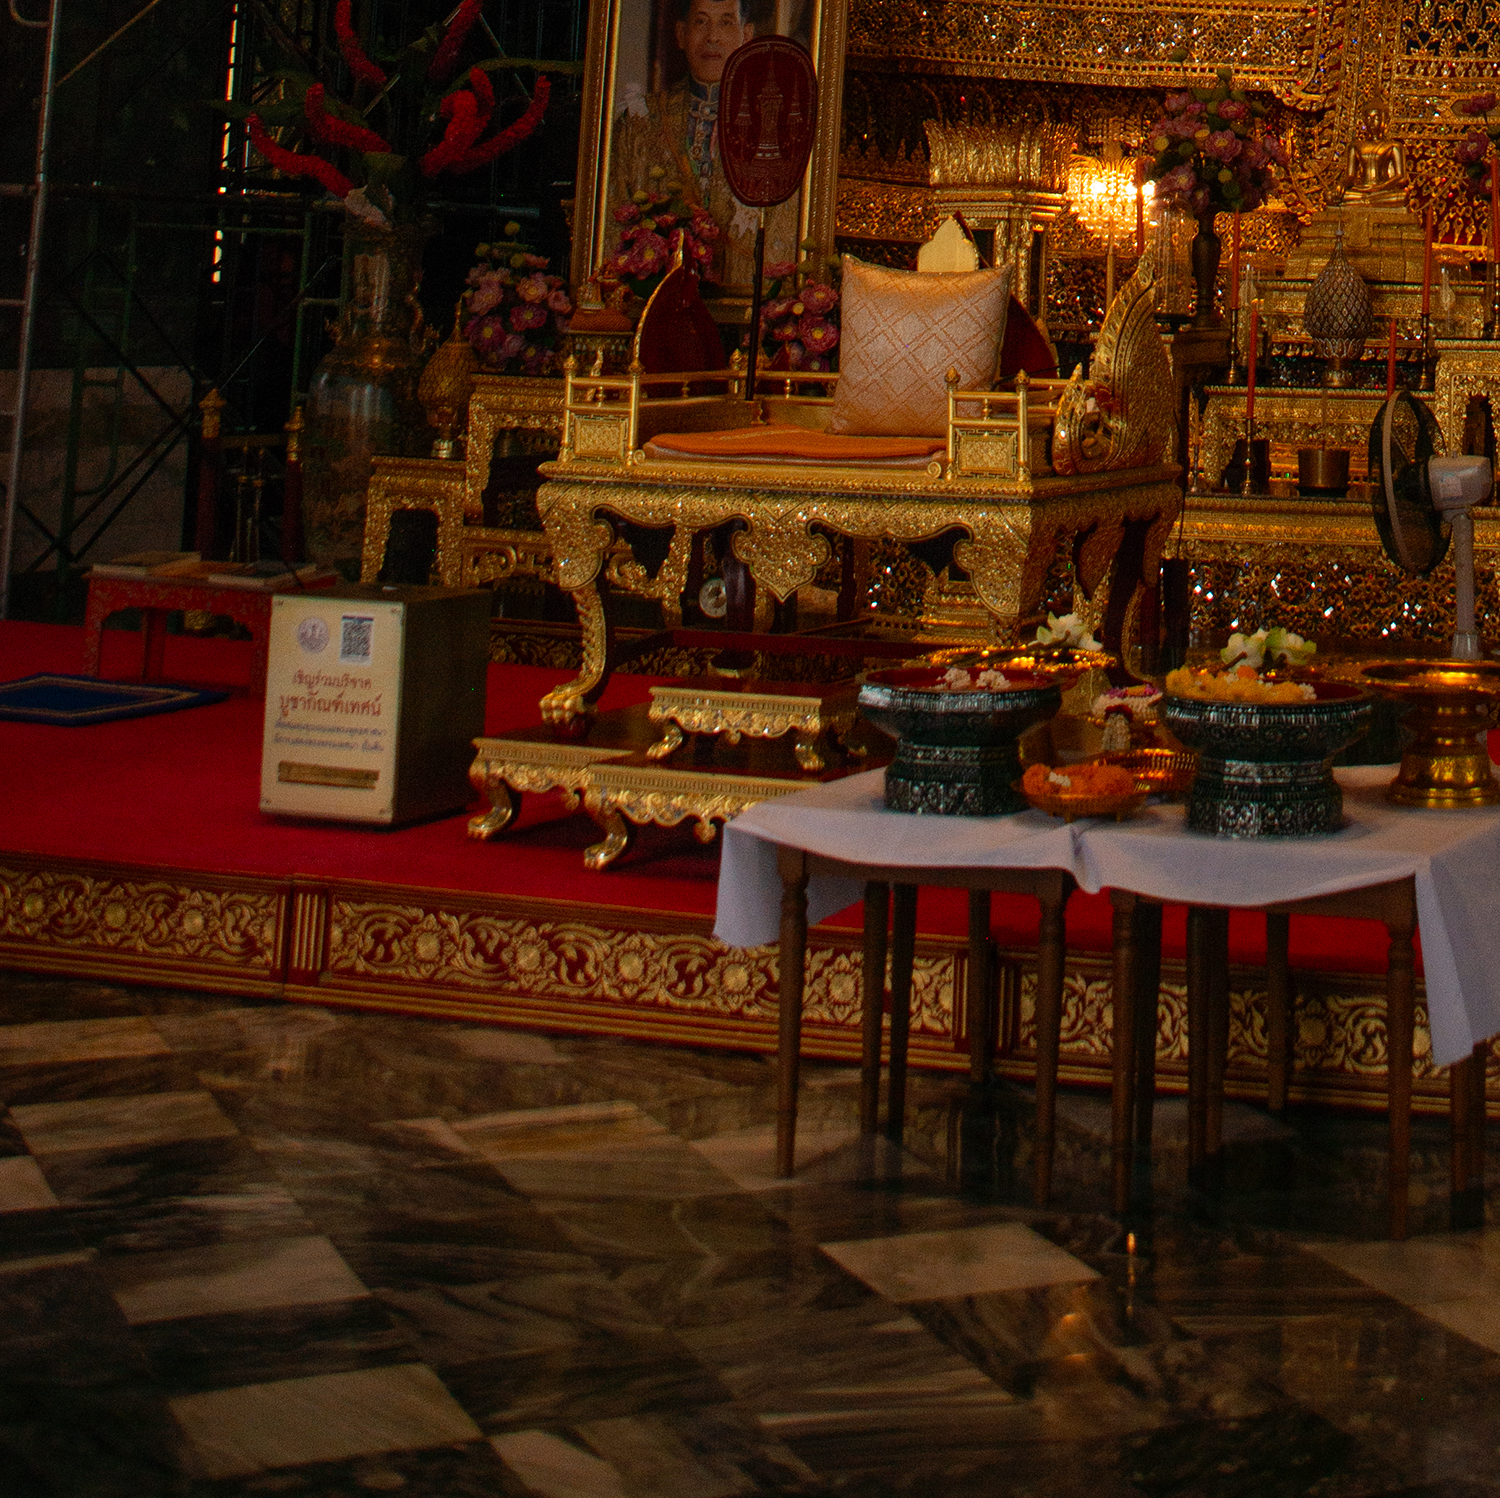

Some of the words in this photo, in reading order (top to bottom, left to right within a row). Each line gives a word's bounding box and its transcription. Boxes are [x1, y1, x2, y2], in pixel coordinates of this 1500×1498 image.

[293, 669, 372, 690] เชิญร่วมบริจาค
[280, 690, 383, 717] บูชากัณฑ์เทศน์
